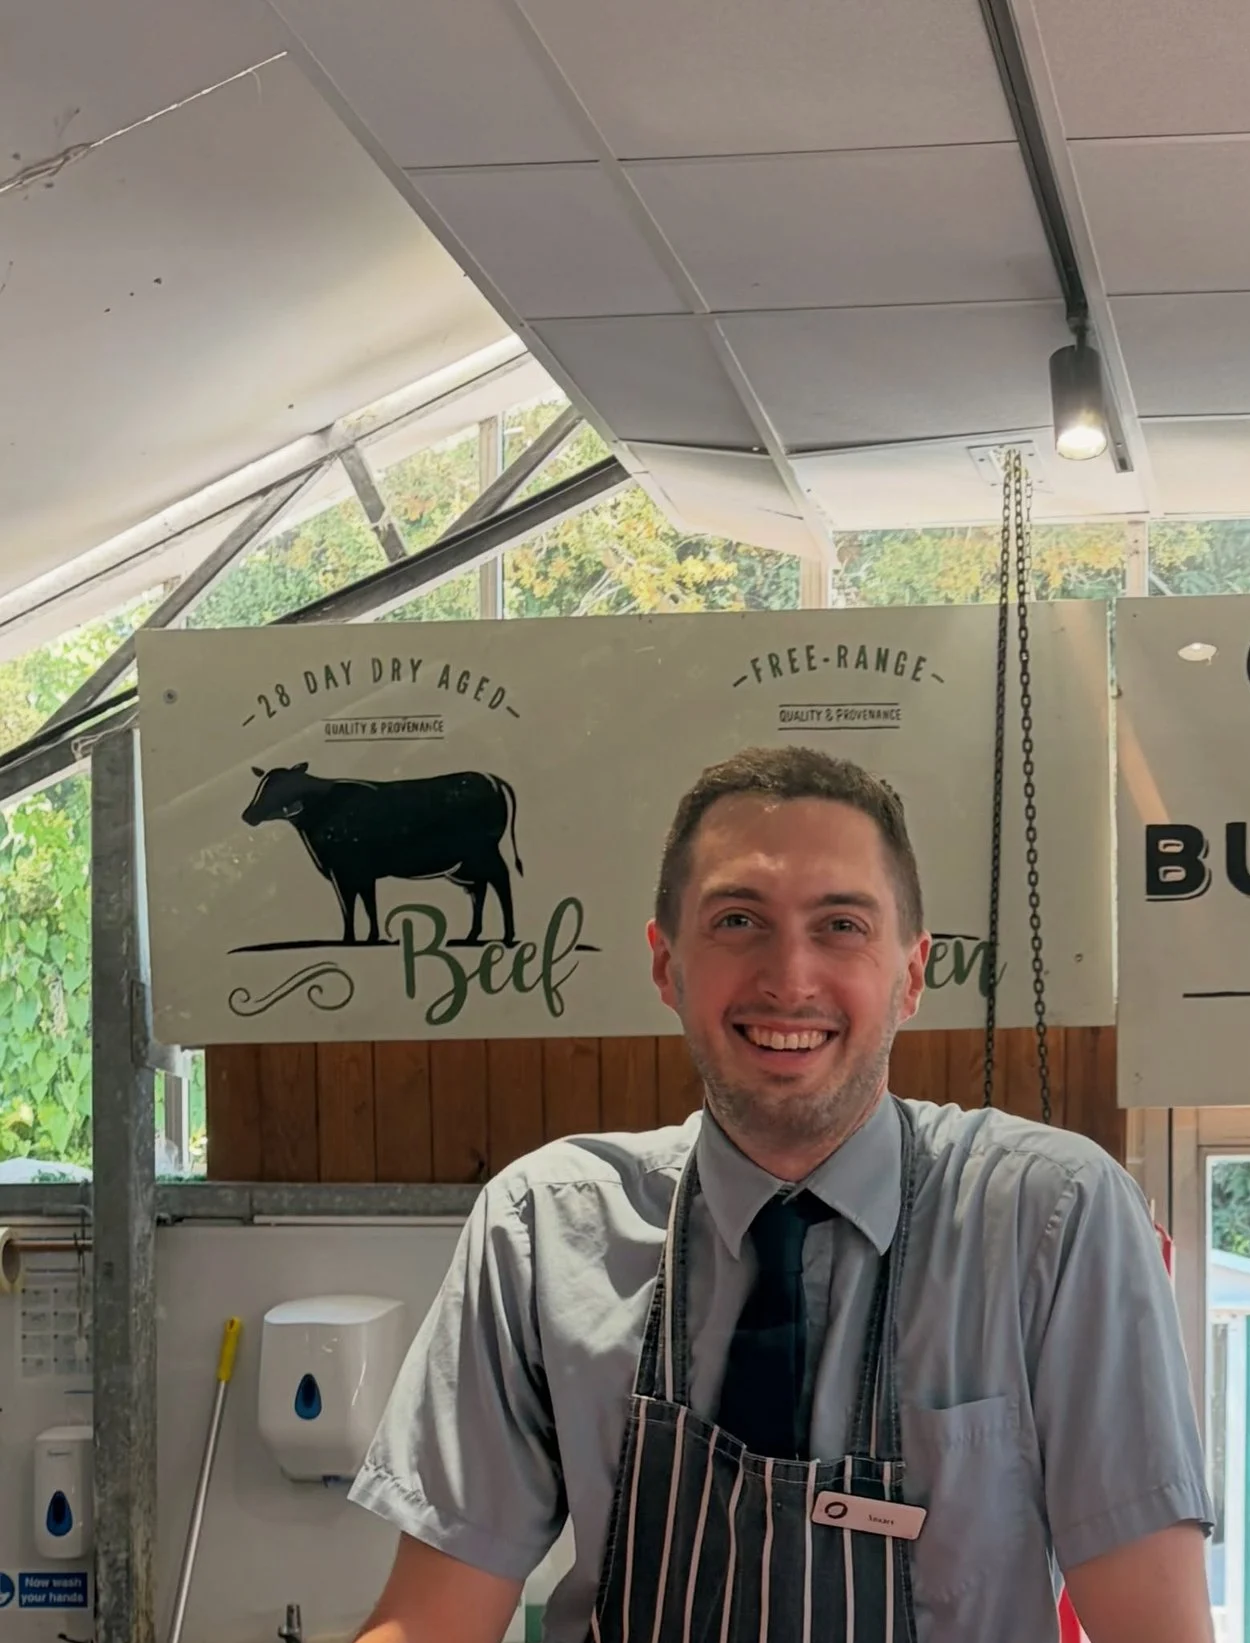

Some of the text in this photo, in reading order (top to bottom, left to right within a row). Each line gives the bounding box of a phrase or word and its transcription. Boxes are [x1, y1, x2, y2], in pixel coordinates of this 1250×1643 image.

[750, 644, 927, 684] FREE-RANGE
[257, 657, 506, 718] 28 DAY DRY AGED
[779, 708, 902, 723] QUALITY & PROVENANCE
[324, 720, 444, 735] QUALITY & PROVENANCE
[385, 896, 586, 1026] Beef
[52, 1577, 82, 1588] wash
[21, 1592, 84, 1605] your hands
